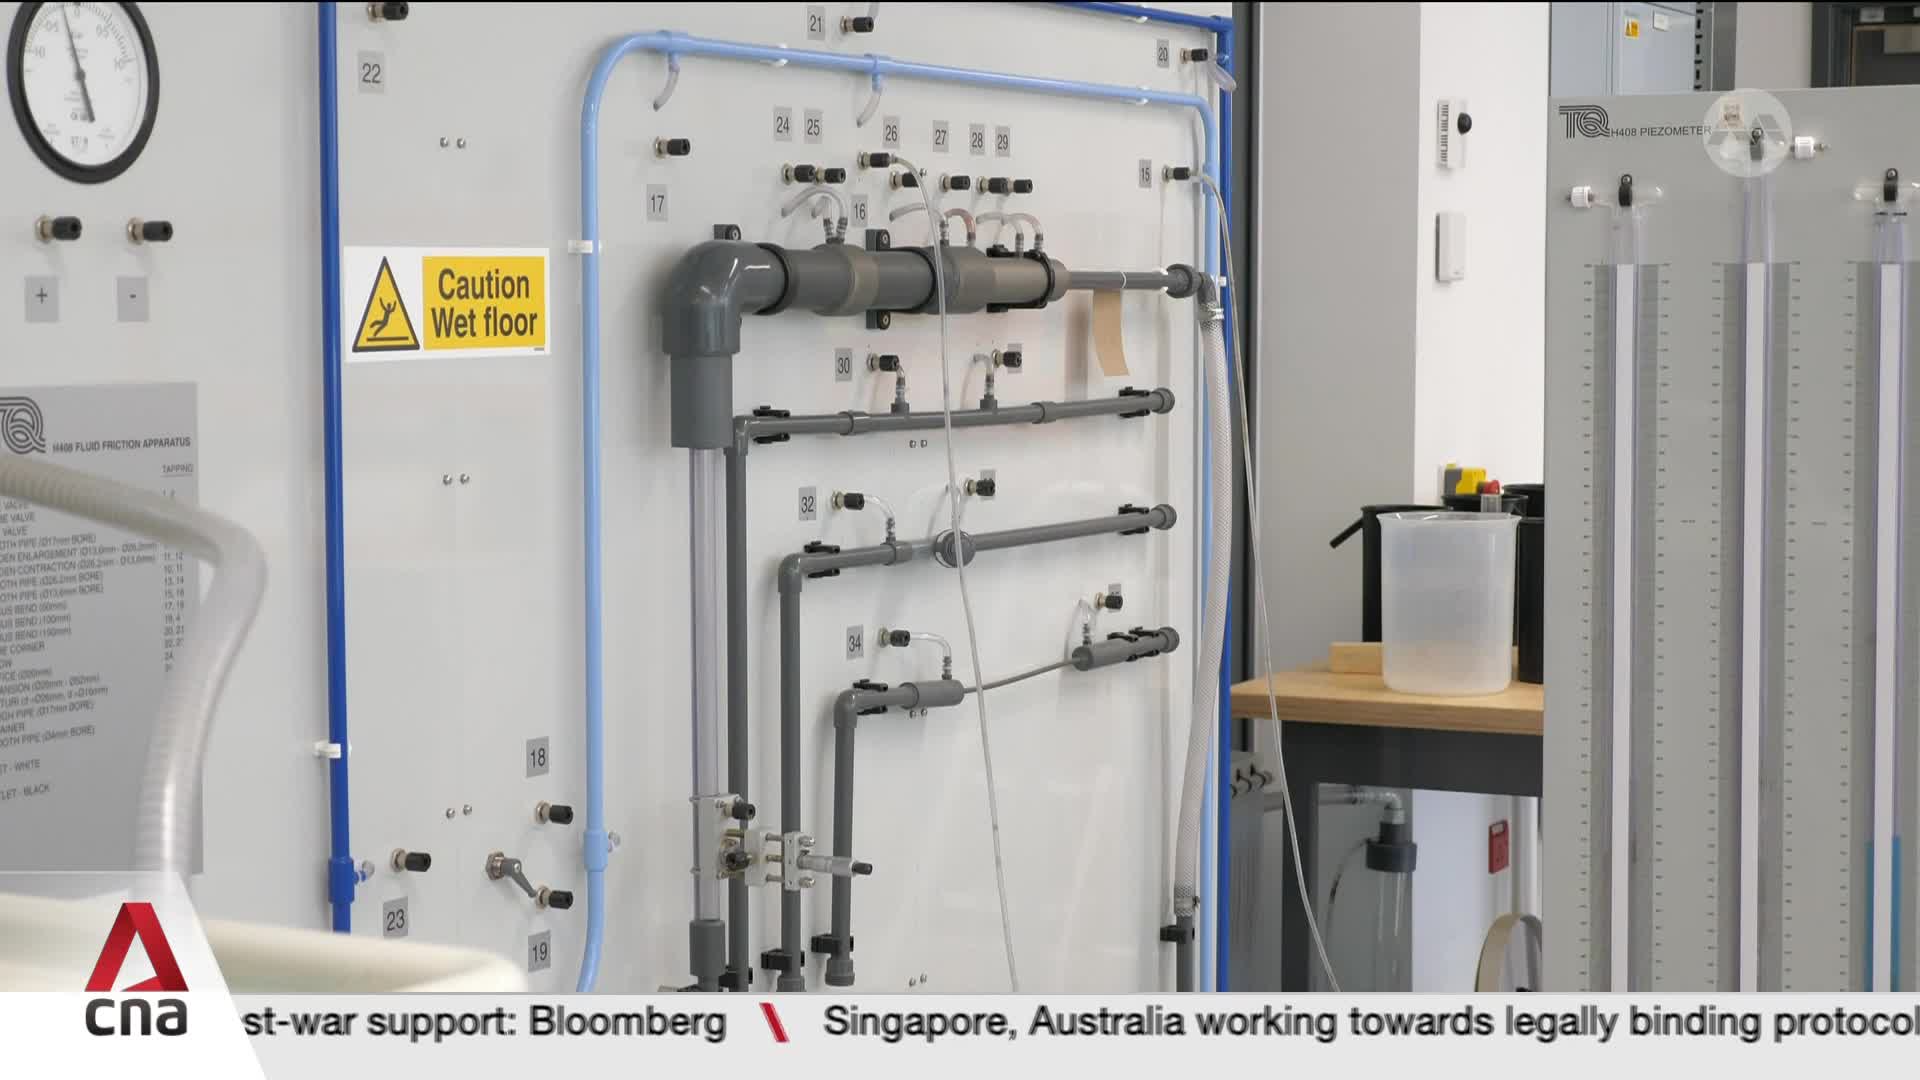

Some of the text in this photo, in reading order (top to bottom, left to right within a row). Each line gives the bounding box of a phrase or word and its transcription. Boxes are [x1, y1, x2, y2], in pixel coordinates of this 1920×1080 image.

[810, 14, 822, 33] 21
[1158, 47, 1168, 62] 20
[362, 62, 381, 84] 22
[776, 115, 790, 134] 24
[807, 118, 820, 137] 25
[885, 124, 898, 142] 26
[1611, 128, 1637, 137] H408
[1640, 125, 1712, 137] PIEZOMETER
[934, 129, 947, 145] 27
[971, 132, 984, 149] 28
[997, 134, 1009, 151] 29
[1141, 167, 1150, 182] 15
[650, 194, 665, 212] 17
[854, 203, 866, 221] 16
[438, 268, 530, 301] Caution
[431, 305, 538, 339] Wet floor
[837, 357, 850, 374] 30
[75, 440, 100, 453] FLUID
[102, 439, 141, 451] FRICTION
[142, 437, 191, 449] APPARATUS
[162, 464, 194, 474] TAPPING
[801, 495, 814, 514] 32
[10, 511, 35, 522] VALVE
[2, 526, 28, 537] VALVE
[17, 547, 77, 562] ENLARGEMENT
[17, 560, 77, 575] CONTRACTION
[14, 602, 37, 615] BEND
[14, 615, 38, 628] BEND
[15, 628, 38, 641] BEND
[848, 634, 862, 653] 34
[15, 759, 41, 772] WHITE
[529, 747, 546, 768] 18
[23, 783, 50, 797] BLACK
[386, 908, 405, 932] 23
[532, 942, 548, 961] 19
